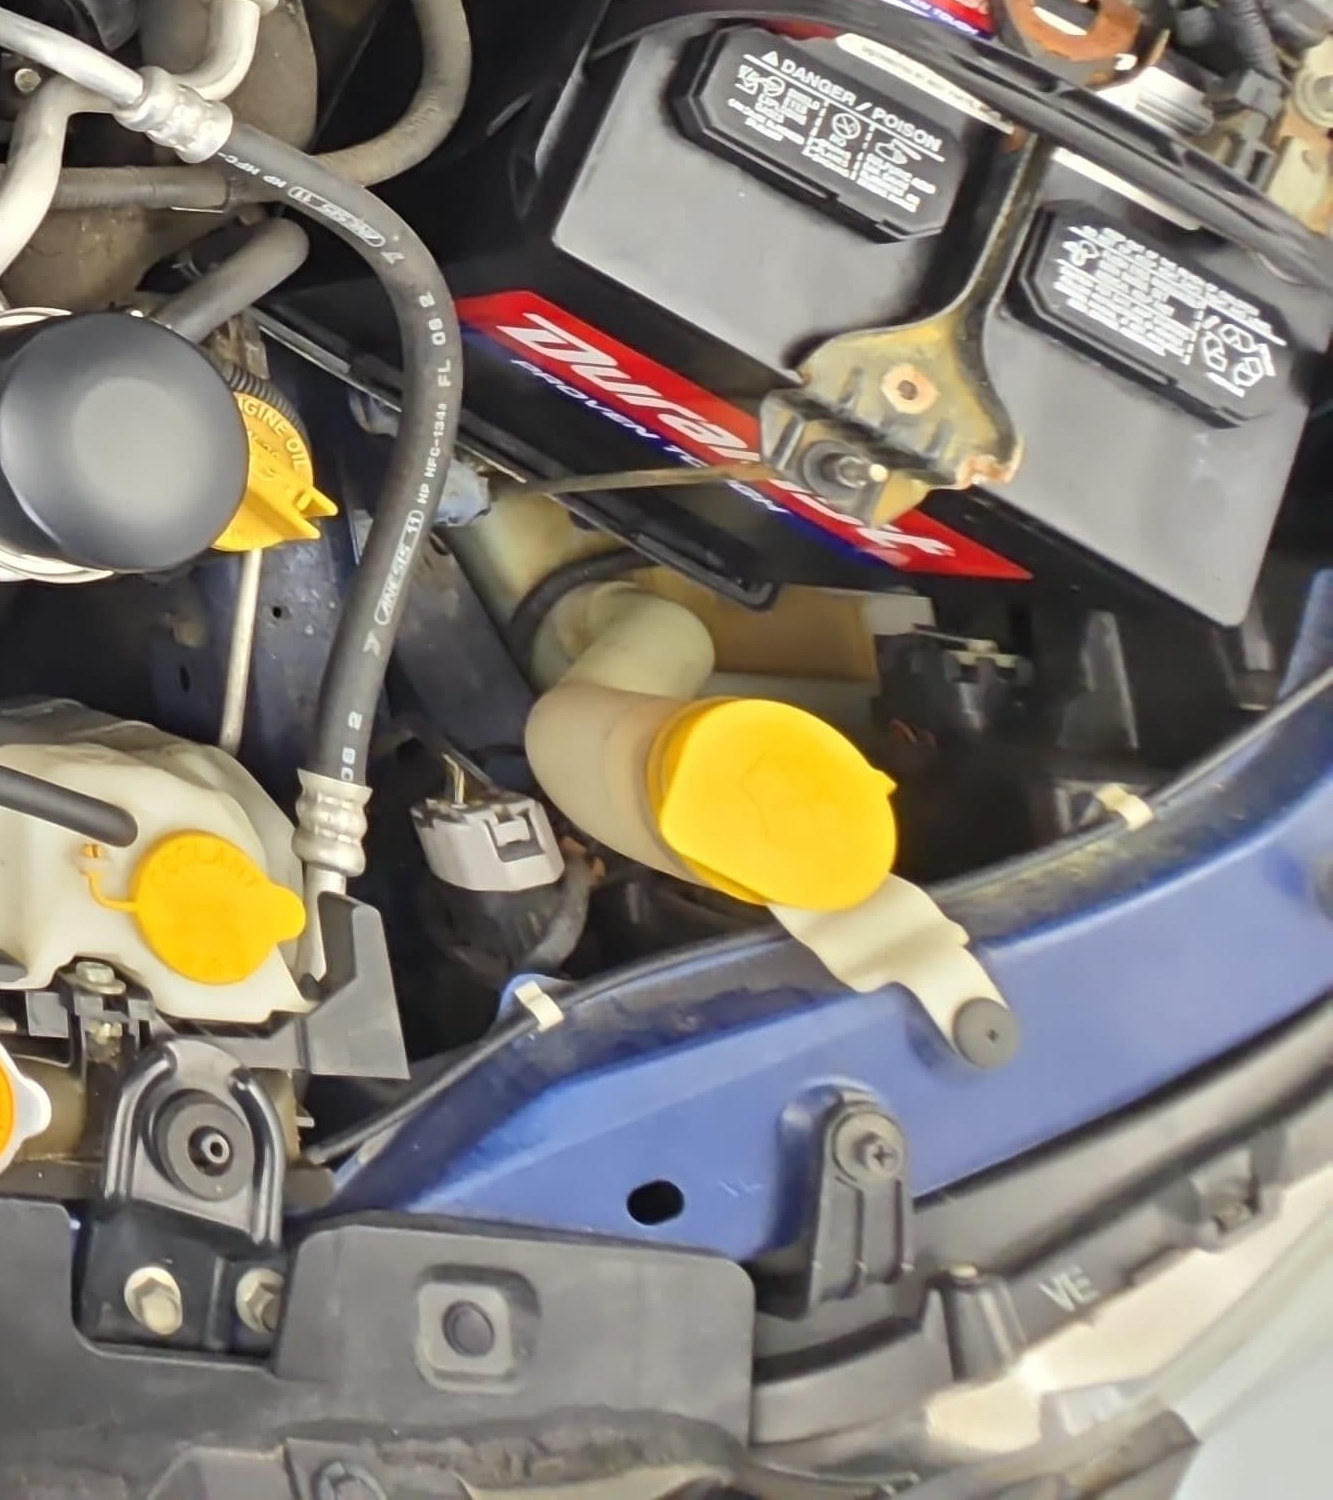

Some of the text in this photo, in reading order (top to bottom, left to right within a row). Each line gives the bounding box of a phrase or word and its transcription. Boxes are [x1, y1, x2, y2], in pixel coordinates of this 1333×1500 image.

[933, 8, 979, 34] TOUGH
[781, 59, 857, 106] DANGER
[872, 107, 943, 152] POISON
[237, 394, 288, 437] GINE
[285, 438, 310, 472] OIL
[416, 484, 430, 505] HP
[438, 360, 452, 388] FL
[510, 359, 791, 513] PROVEN TOGH
